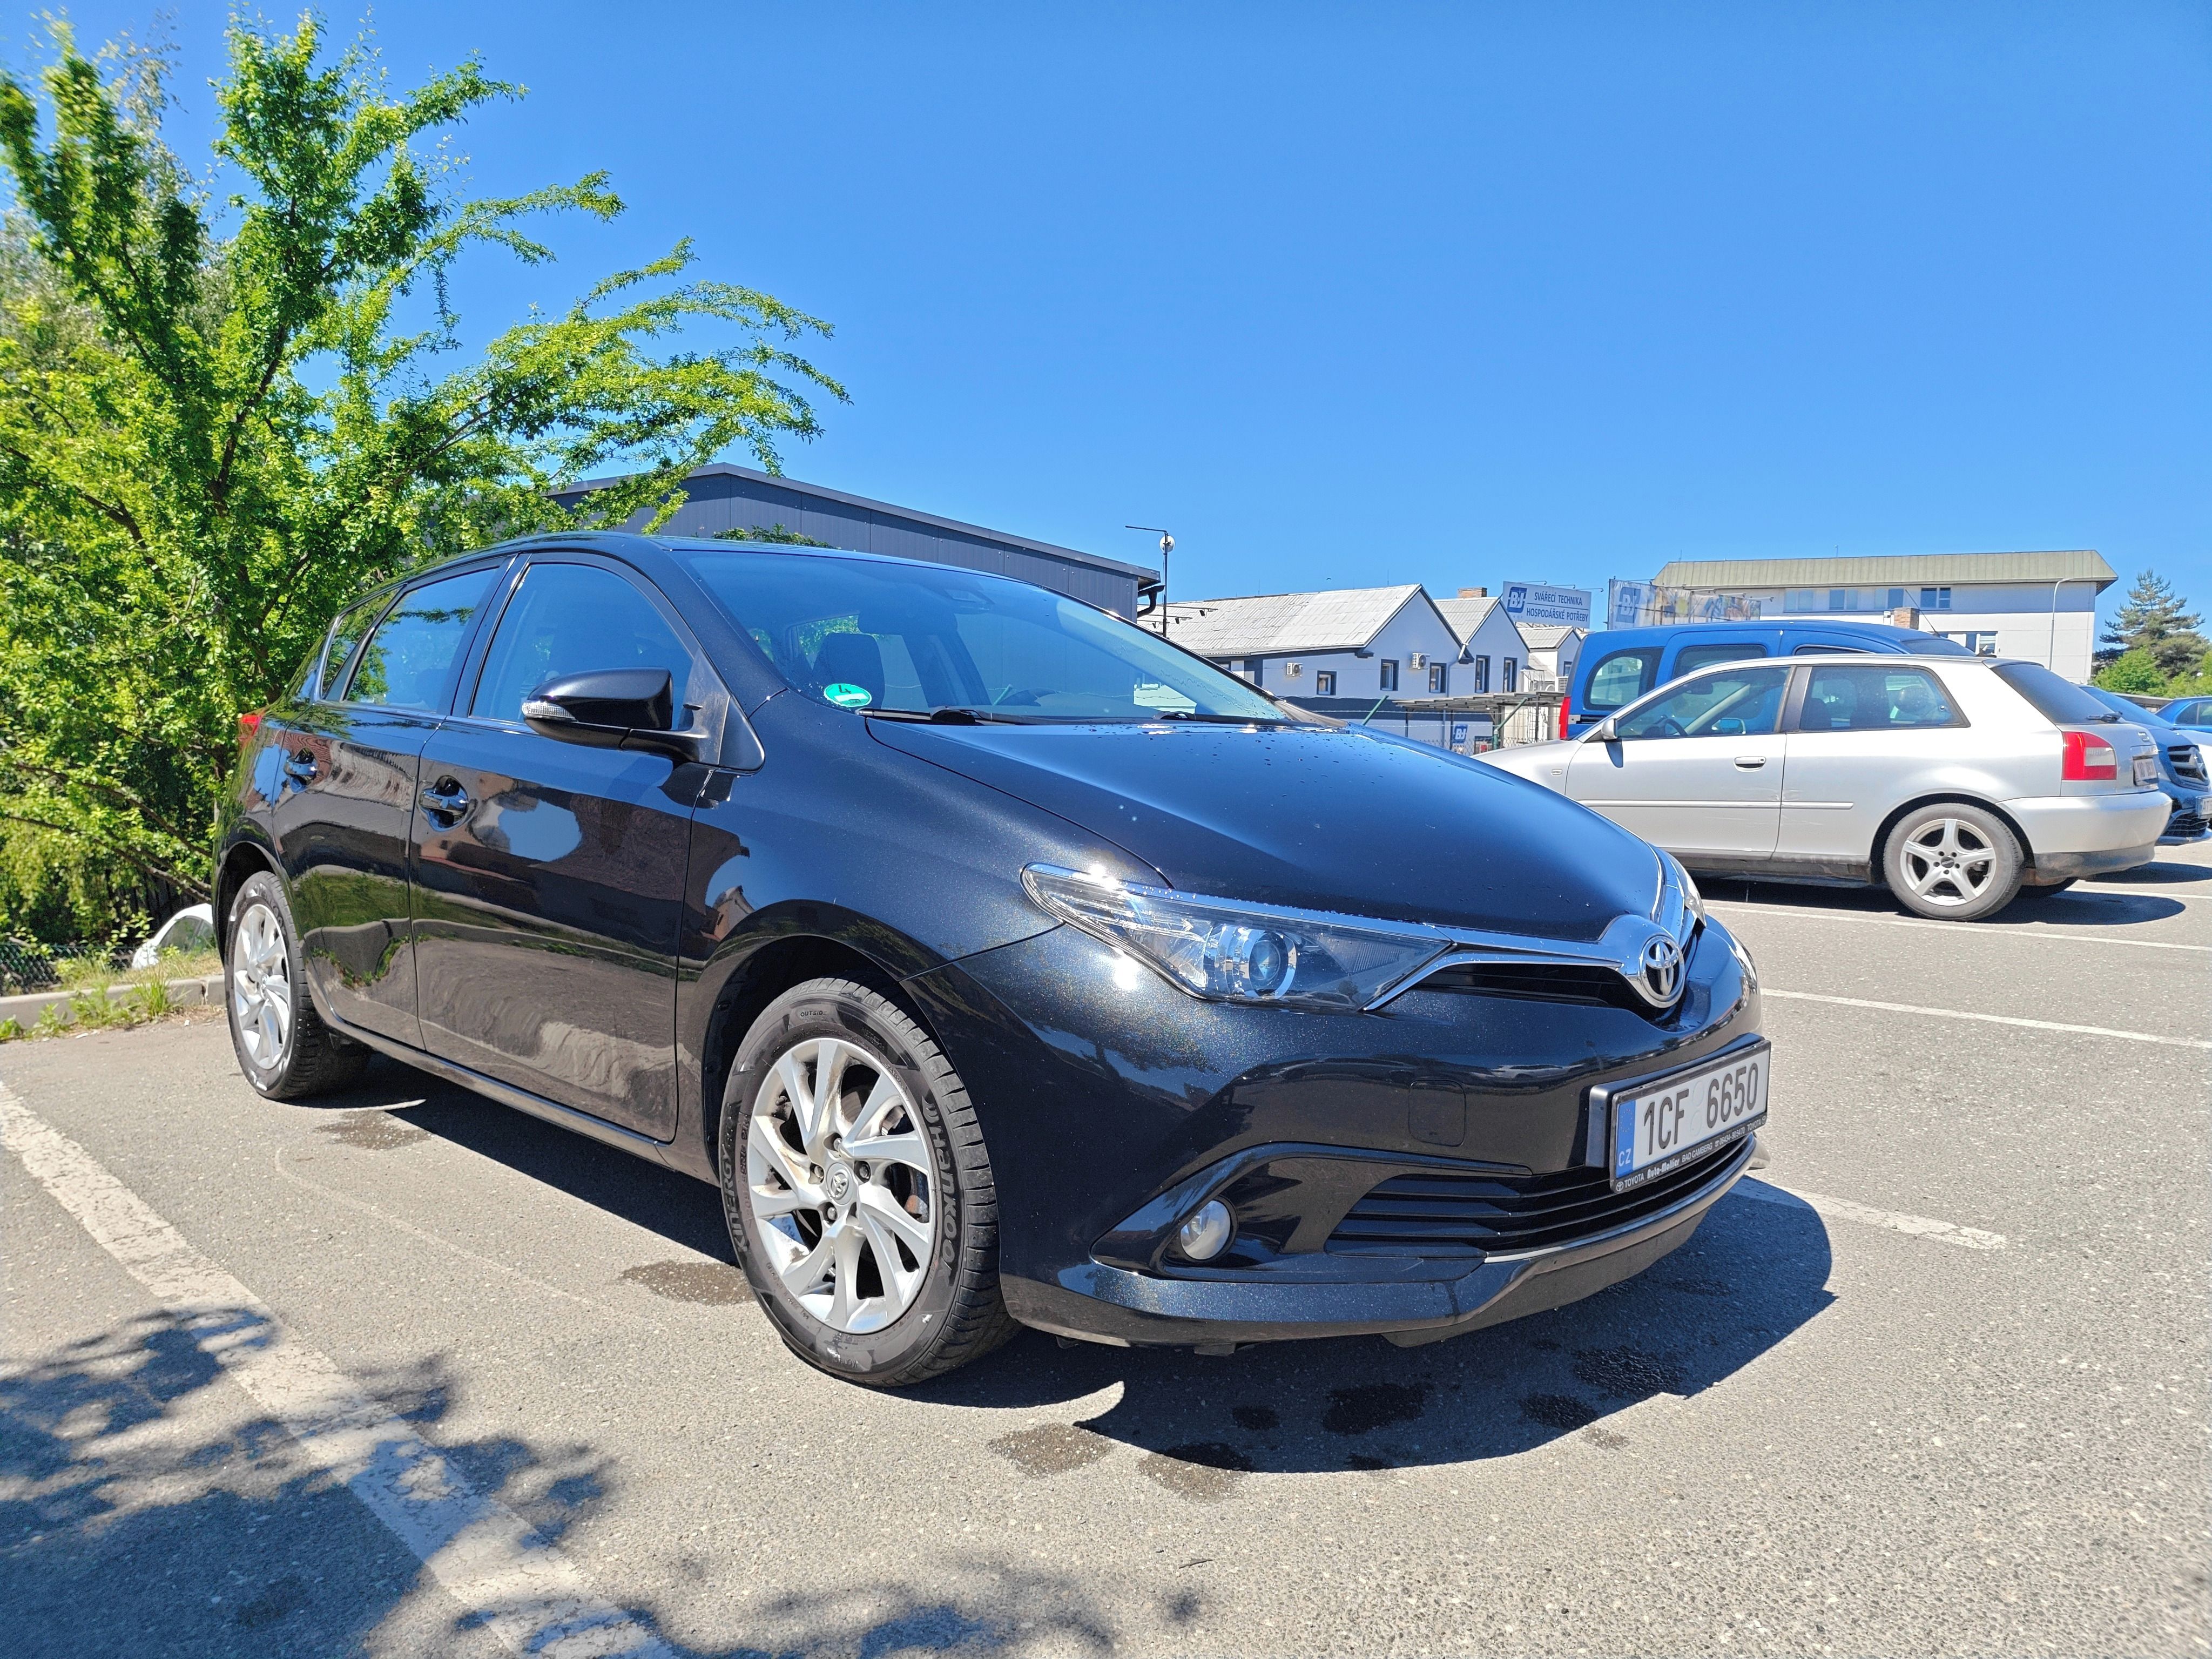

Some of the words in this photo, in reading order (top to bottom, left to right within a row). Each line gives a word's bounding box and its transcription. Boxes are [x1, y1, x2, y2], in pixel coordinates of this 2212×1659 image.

[1534, 591, 1556, 603] SVÁŘECÍ
[1558, 595, 1582, 605] TECHNIKA
[1527, 608, 1565, 620] HOSPODÁŘSKÉ
[1567, 610, 1589, 622] POTŘEBY
[1644, 1089, 1689, 1156] 1CF
[1707, 1062, 1758, 1129] 6650
[1618, 1148, 1631, 1166] CZ
[1624, 1173, 1644, 1188] TOYOTA
[1647, 1158, 1680, 1179] Auto-Mollier
[1682, 1152, 1692, 1163] BAD
[1691, 1142, 1713, 1159] CAMBERG
